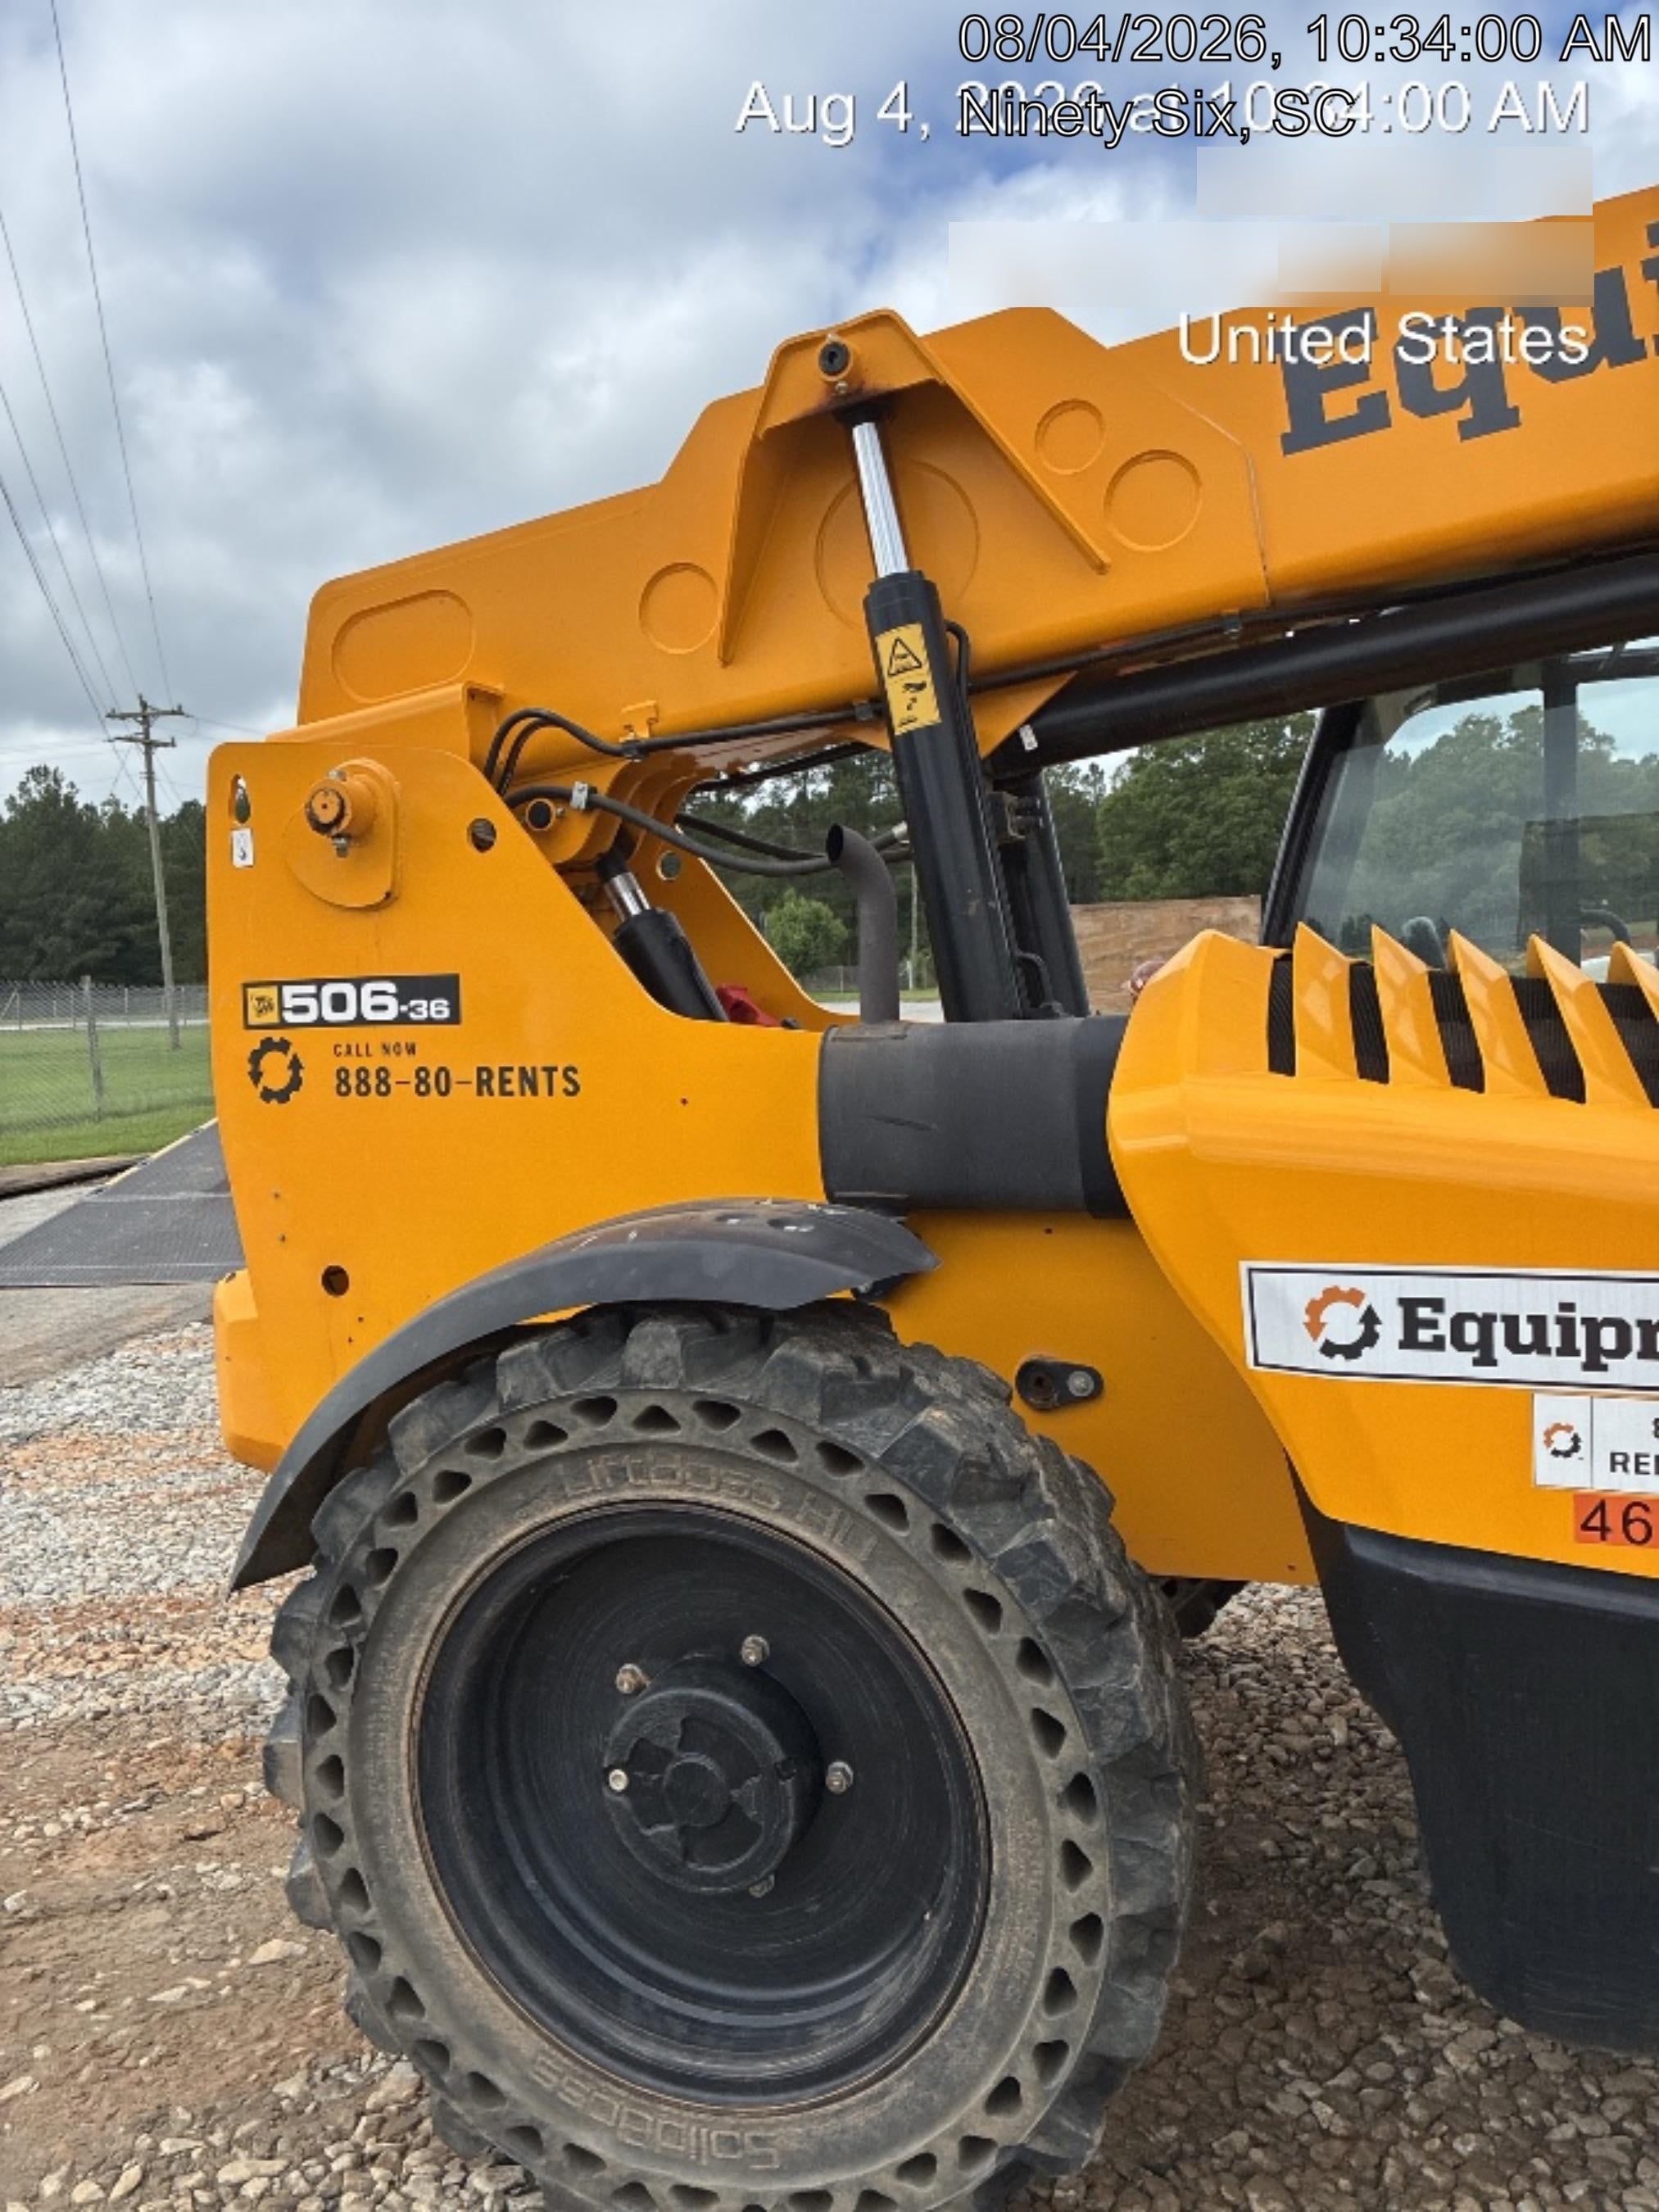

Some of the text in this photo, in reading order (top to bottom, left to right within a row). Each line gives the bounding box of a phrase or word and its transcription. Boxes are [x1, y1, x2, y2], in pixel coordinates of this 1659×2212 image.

[281, 981, 451, 1023] 506-36
[333, 1041, 417, 1058] CALL NOW
[334, 1066, 581, 1098] 888-80-RENTS
[1610, 1451, 1659, 1475] RE
[1580, 1498, 1653, 1546] 46
